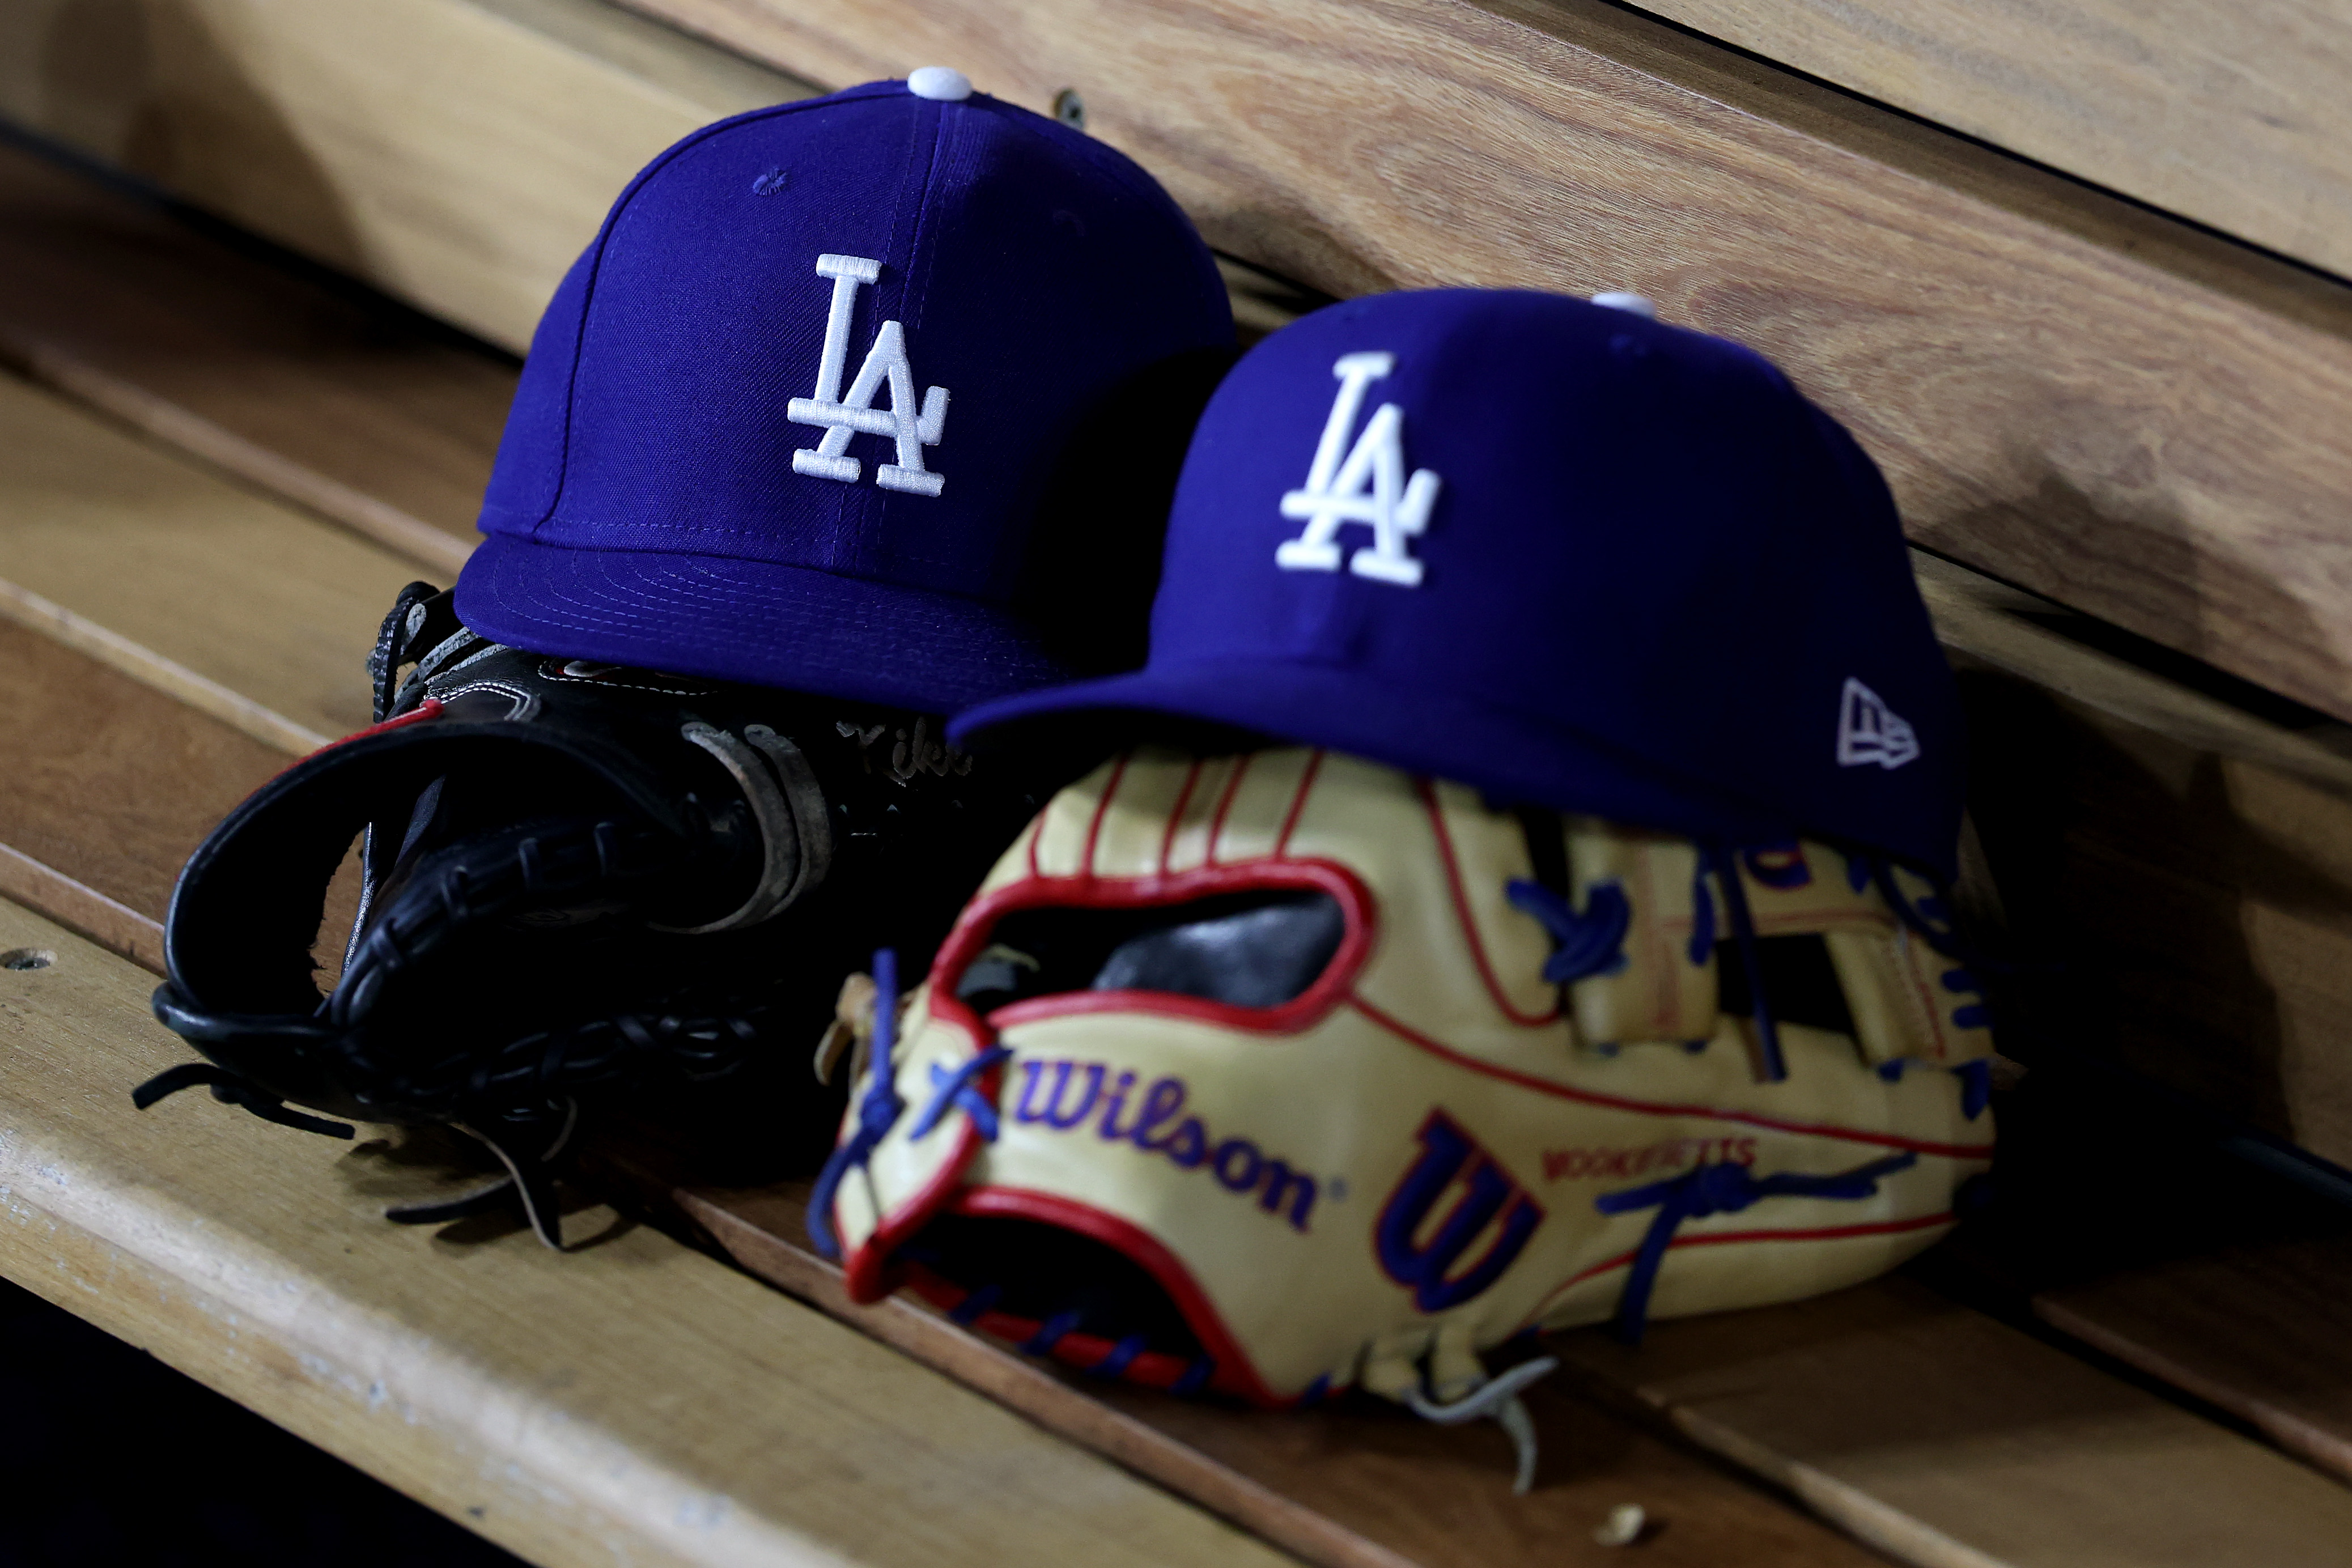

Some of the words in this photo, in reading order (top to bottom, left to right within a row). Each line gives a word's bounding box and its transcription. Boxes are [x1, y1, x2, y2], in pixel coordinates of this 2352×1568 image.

[787, 253, 950, 496] LA
[1275, 351, 1441, 587] LA
[1013, 1060, 1318, 1233] Wilson
[1373, 1104, 1547, 1315] W
